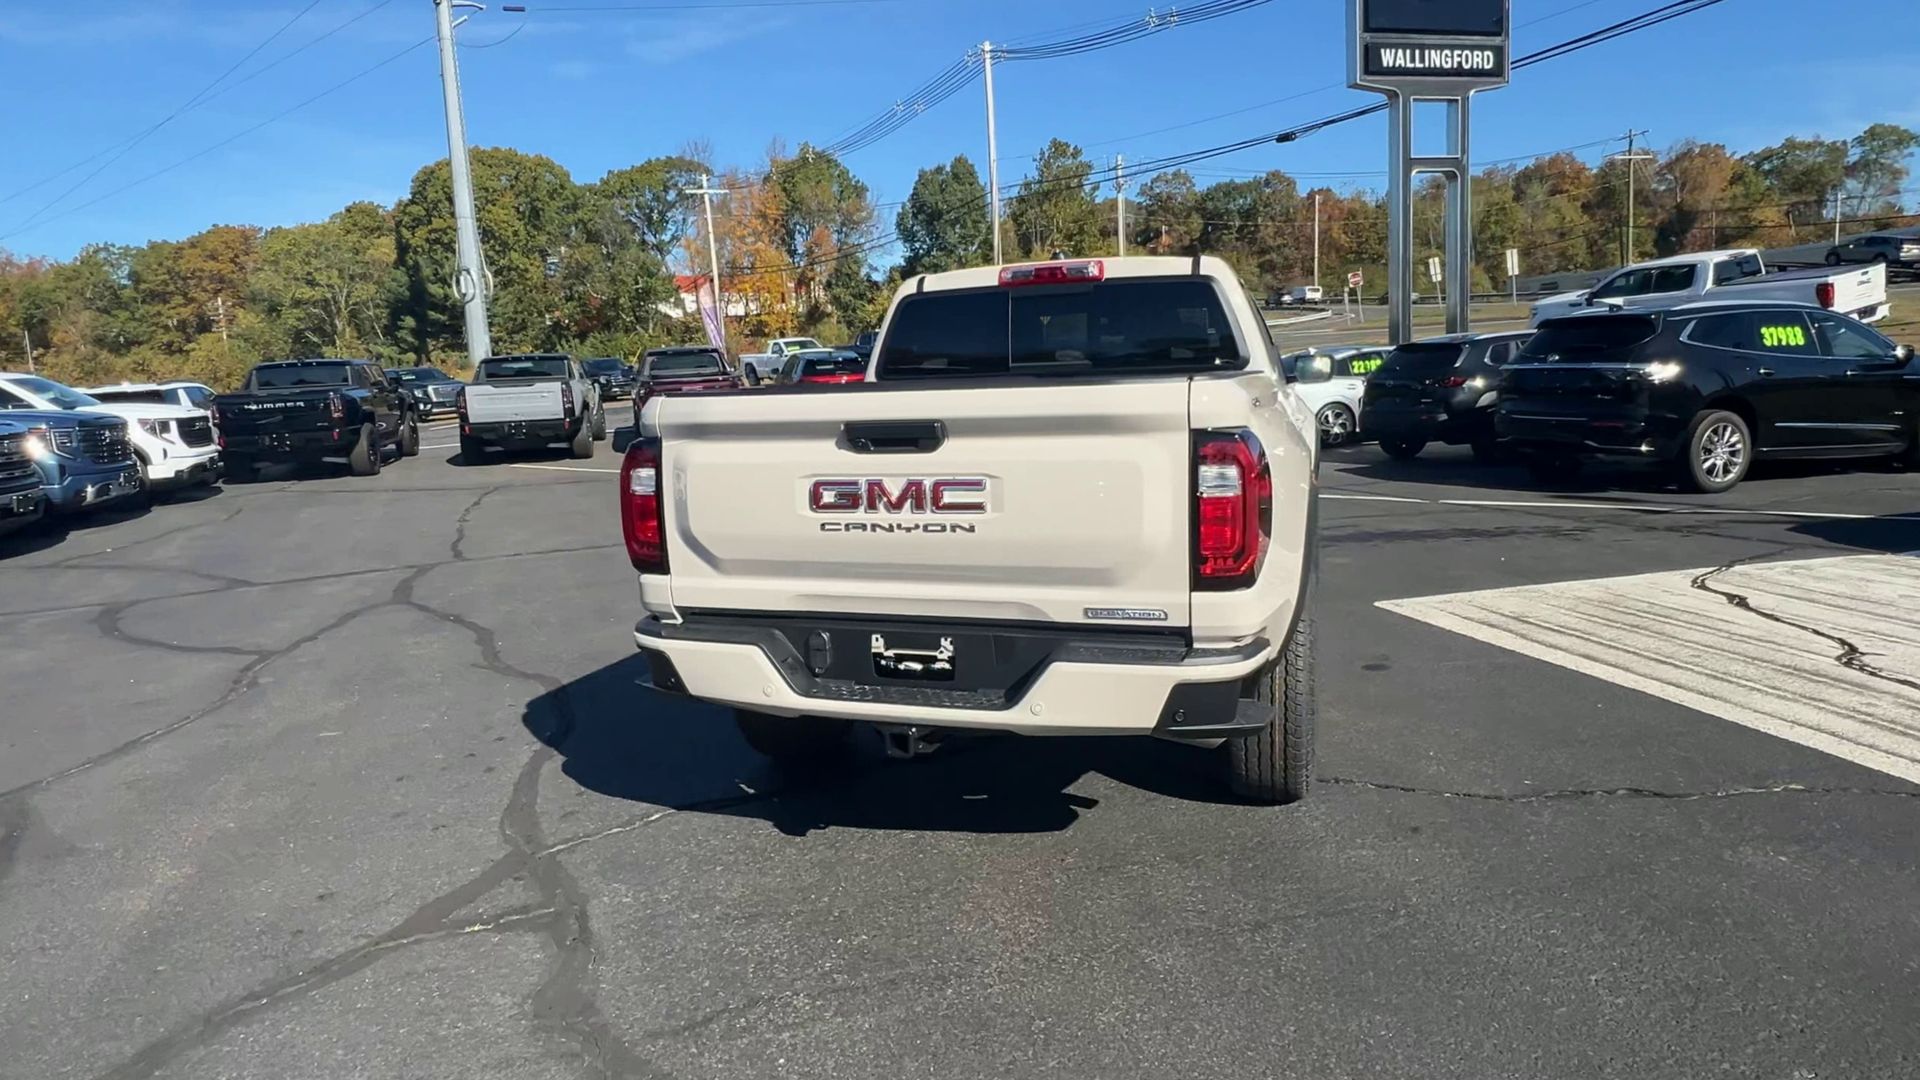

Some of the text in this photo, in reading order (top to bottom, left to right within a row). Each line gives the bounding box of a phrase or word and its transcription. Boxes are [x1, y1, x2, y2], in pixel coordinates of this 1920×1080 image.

[1380, 48, 1494, 70] WALLINGFORD
[1760, 326, 1805, 347] 37988
[809, 478, 988, 515] GMC
[819, 522, 977, 534] CANYON
